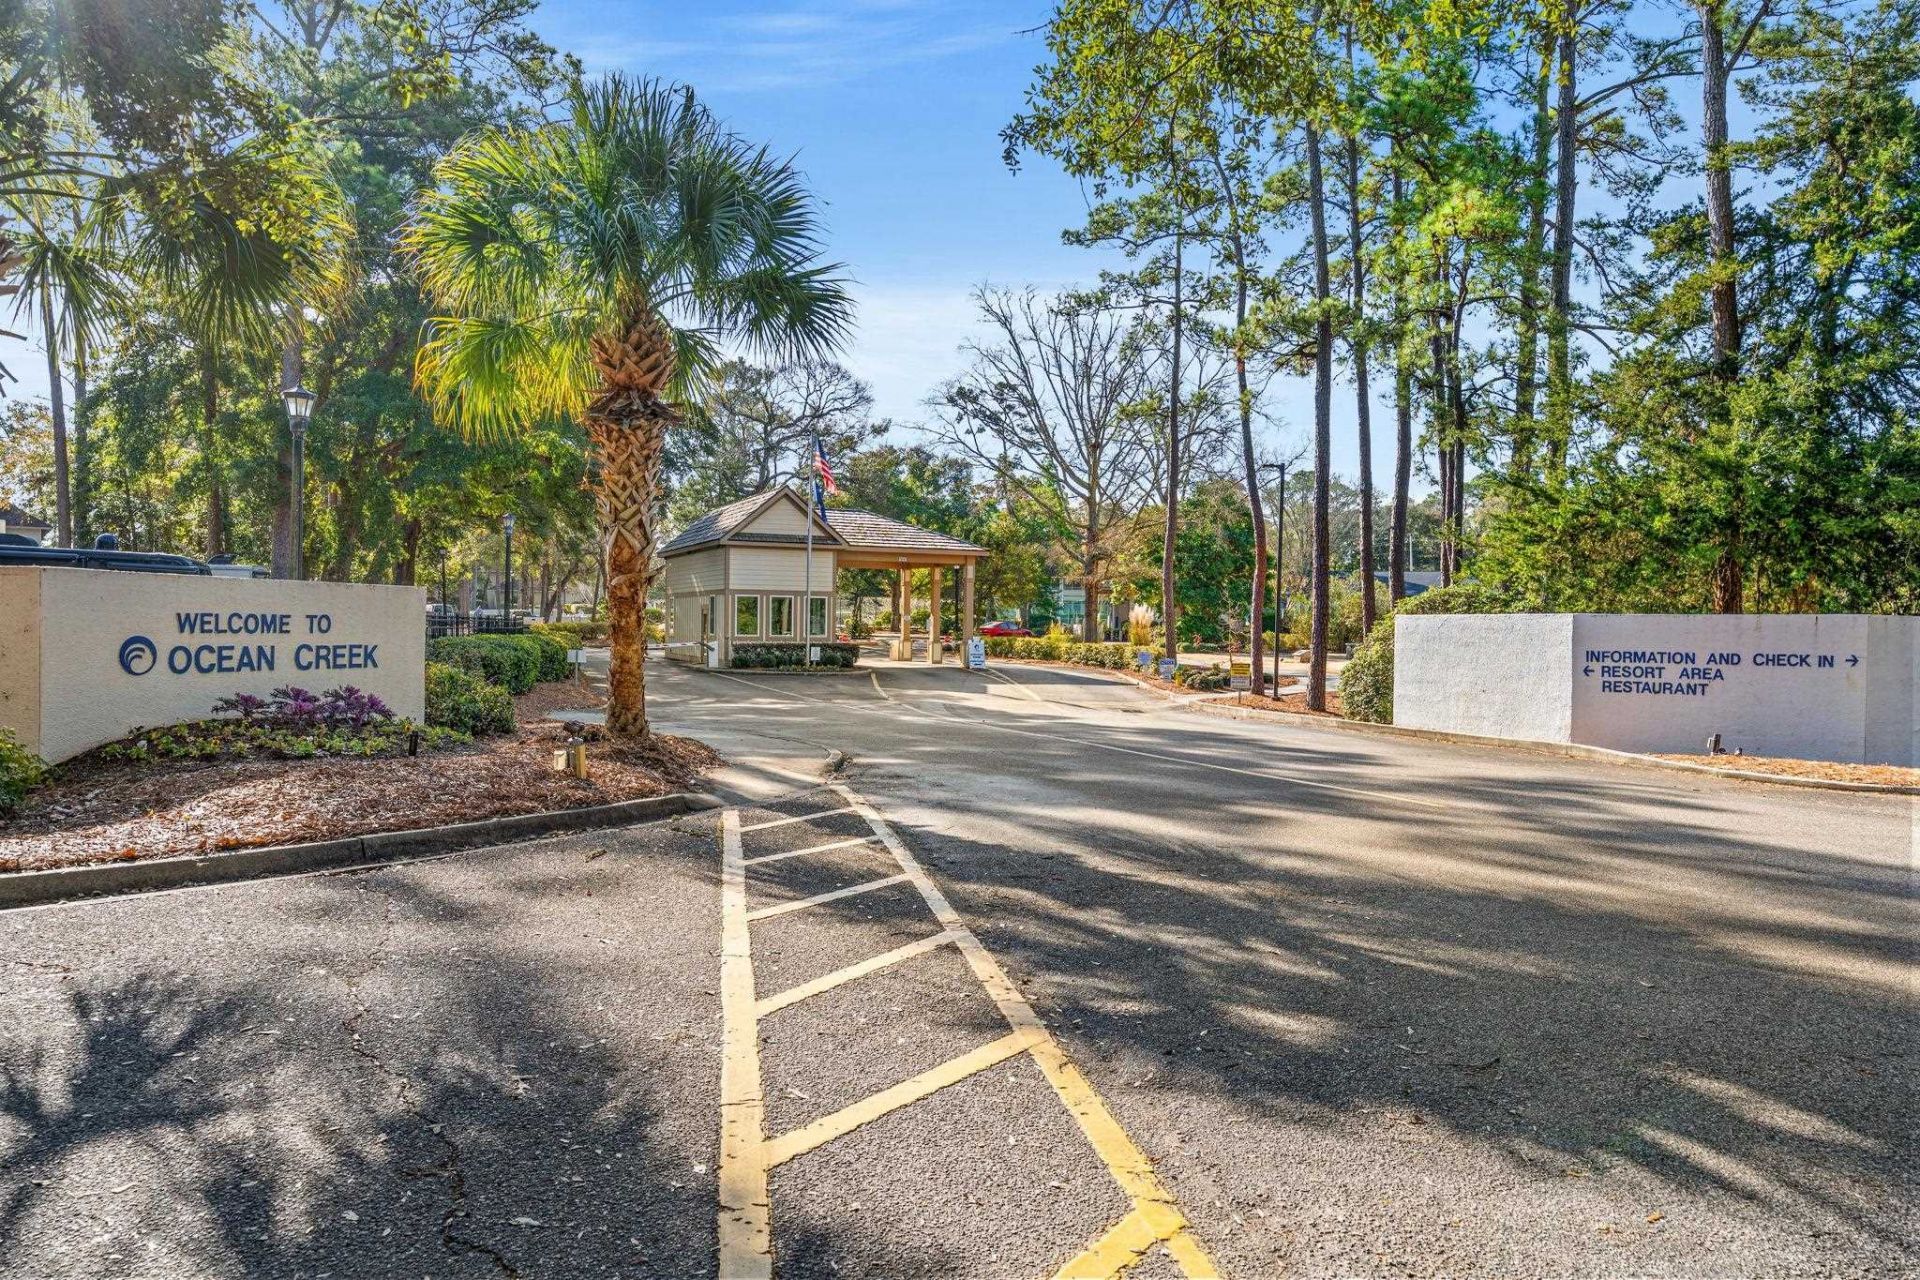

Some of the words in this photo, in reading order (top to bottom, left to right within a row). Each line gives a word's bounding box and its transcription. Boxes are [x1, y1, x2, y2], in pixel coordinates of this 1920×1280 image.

[176, 612, 291, 635] WELCOME
[305, 613, 332, 635] TO
[168, 644, 275, 675] OCEAN
[294, 643, 379, 671] CREEK
[1586, 650, 1696, 665] INFORMATION
[1706, 653, 1741, 666] AND
[1753, 653, 1811, 668] CHECK
[1818, 655, 1835, 668] IN
[1601, 665, 1665, 679] RESORT
[1679, 667, 1724, 681] AREA
[1602, 681, 1709, 696] RESTAURANT
